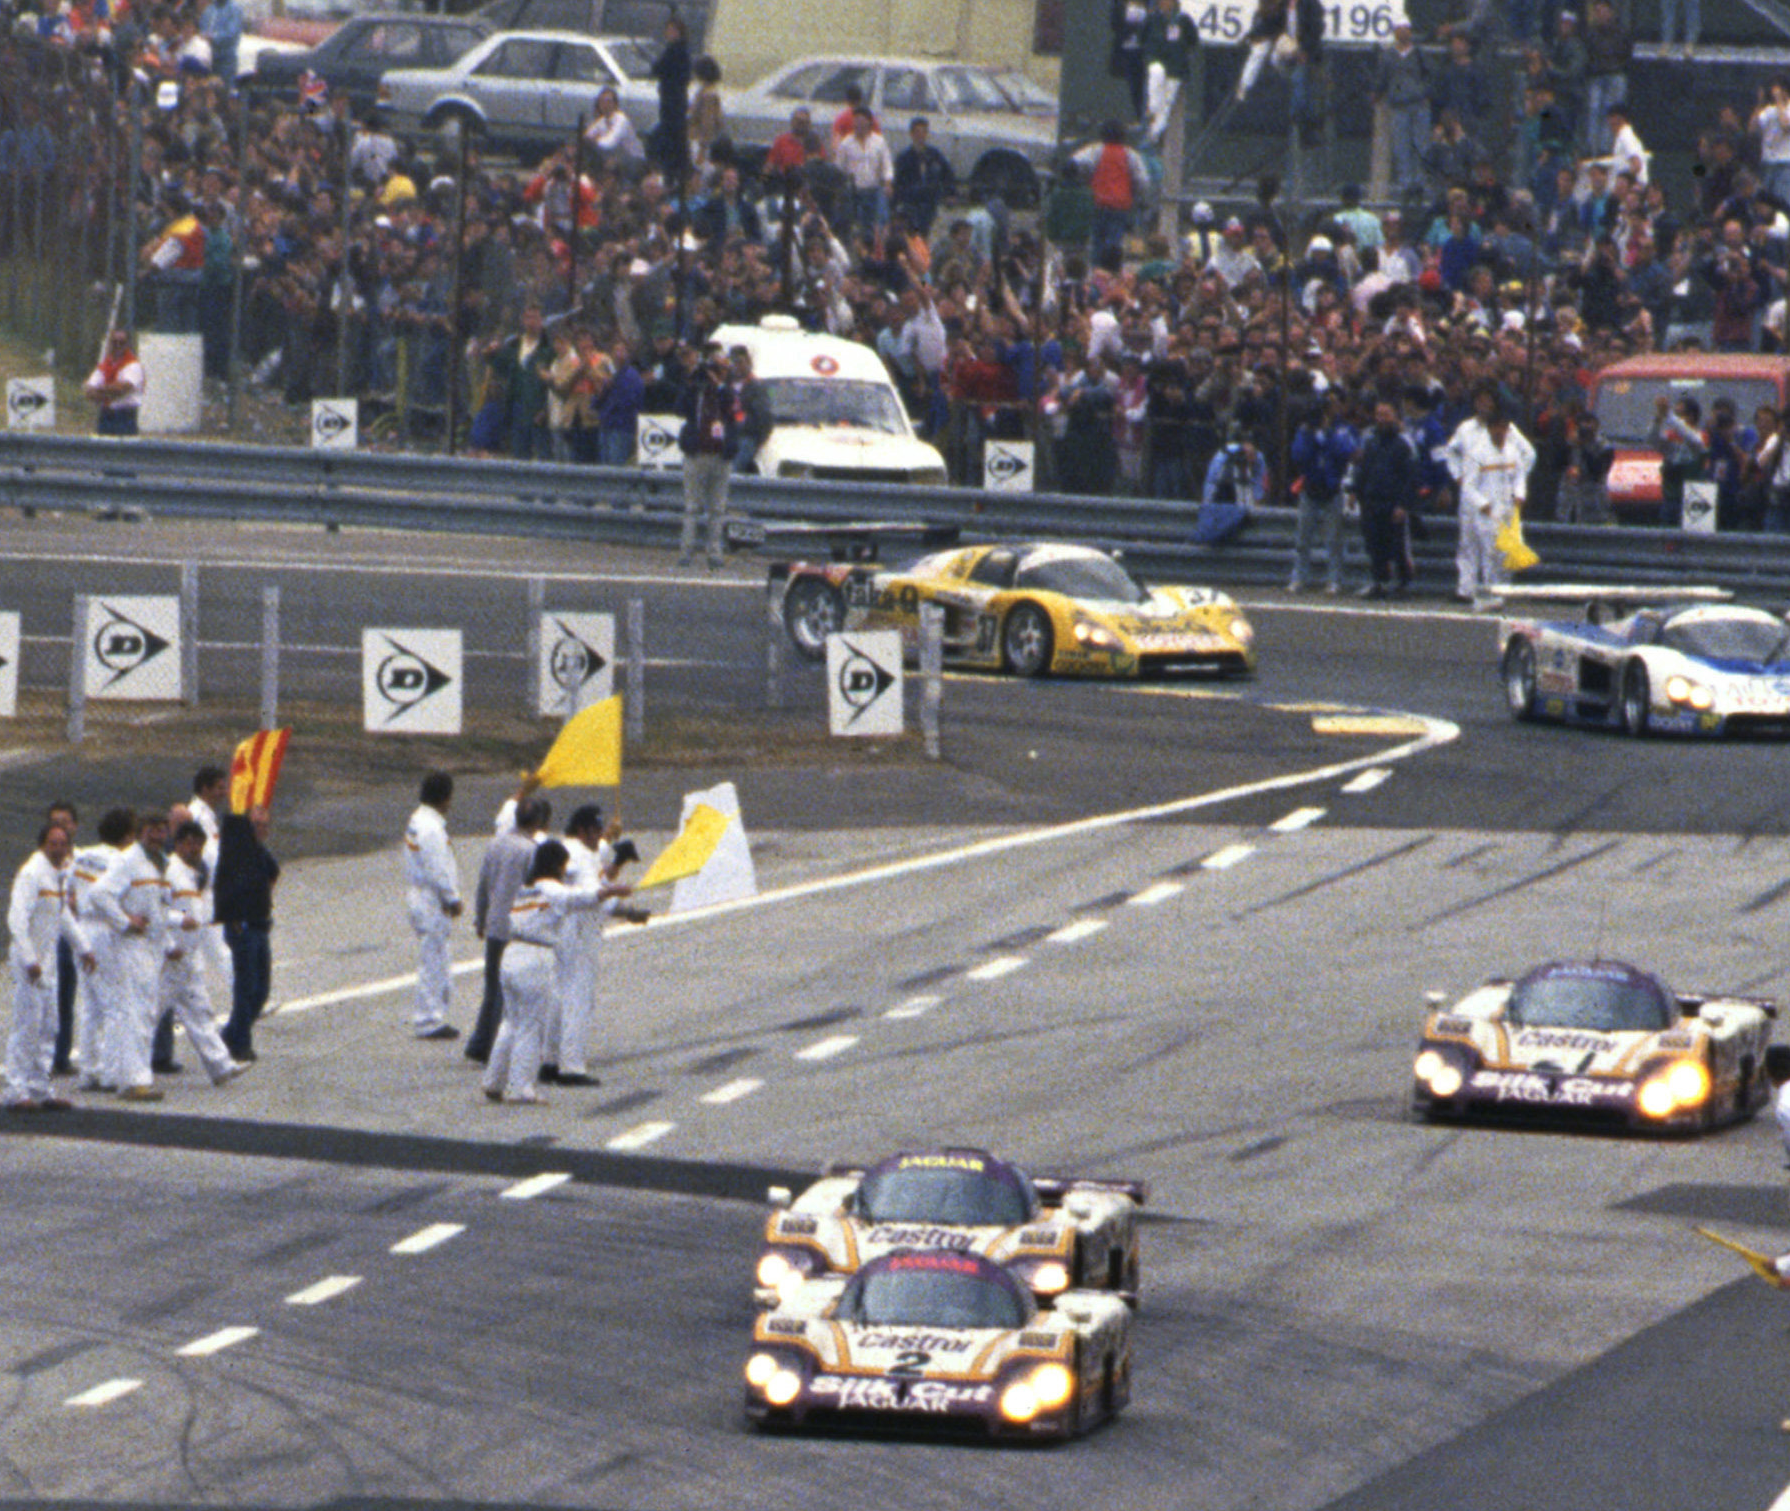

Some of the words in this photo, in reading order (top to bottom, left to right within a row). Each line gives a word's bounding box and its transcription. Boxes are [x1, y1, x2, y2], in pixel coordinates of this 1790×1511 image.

[1200, 5, 1242, 38] 45
[1328, 5, 1393, 37] 196
[897, 1156, 985, 1173] JAGUAR
[858, 1331, 973, 1353] Castrol
[886, 1350, 932, 1377] 2
[809, 1375, 900, 1397] Silk
[910, 1381, 995, 1403] Cut
[838, 1388, 950, 1413] JAGUAR
